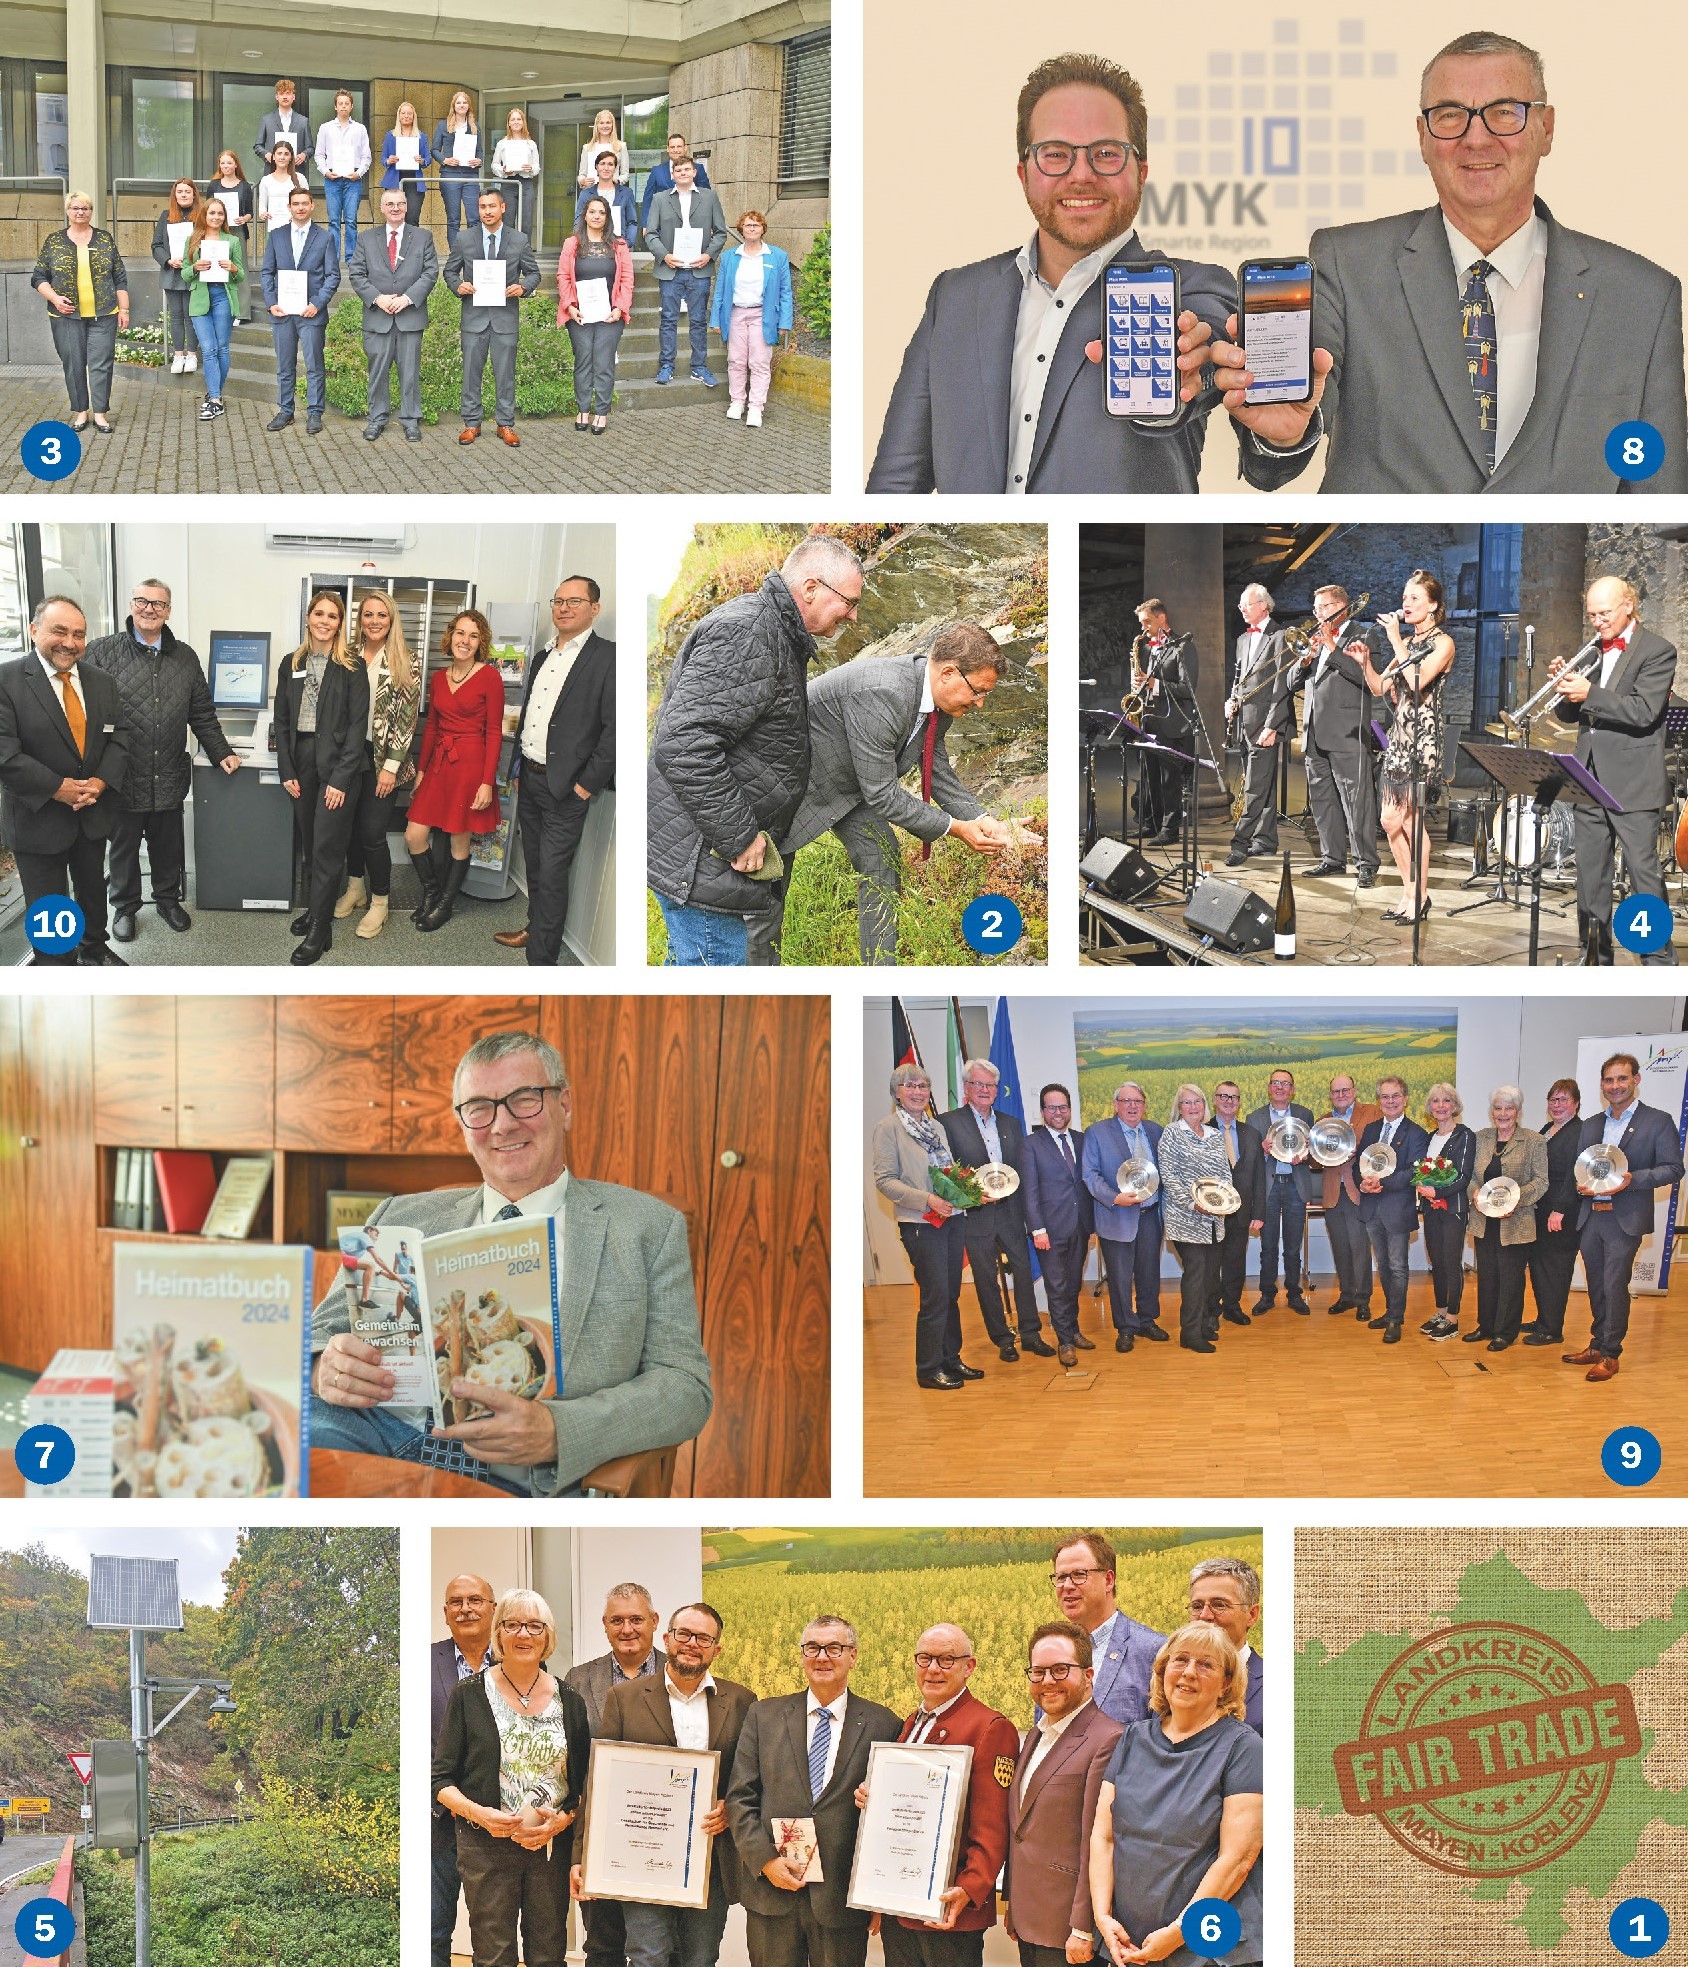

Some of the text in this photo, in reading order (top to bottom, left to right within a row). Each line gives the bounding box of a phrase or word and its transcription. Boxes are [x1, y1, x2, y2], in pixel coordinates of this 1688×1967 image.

[1140, 181, 1268, 227] MYK
[1209, 234, 1271, 254] Region
[434, 1237, 541, 1278] Heimatbuch
[507, 1258, 541, 1276] 2024
[135, 1270, 291, 1299] Heimatbuch
[242, 1303, 290, 1323] 2024
[354, 1319, 421, 1332] Gemeinsam
[361, 1335, 422, 1347] ewachsen.
[1378, 1639, 1576, 1727] LANDKREIS
[1350, 1698, 1626, 1803] FAIR TRADE
